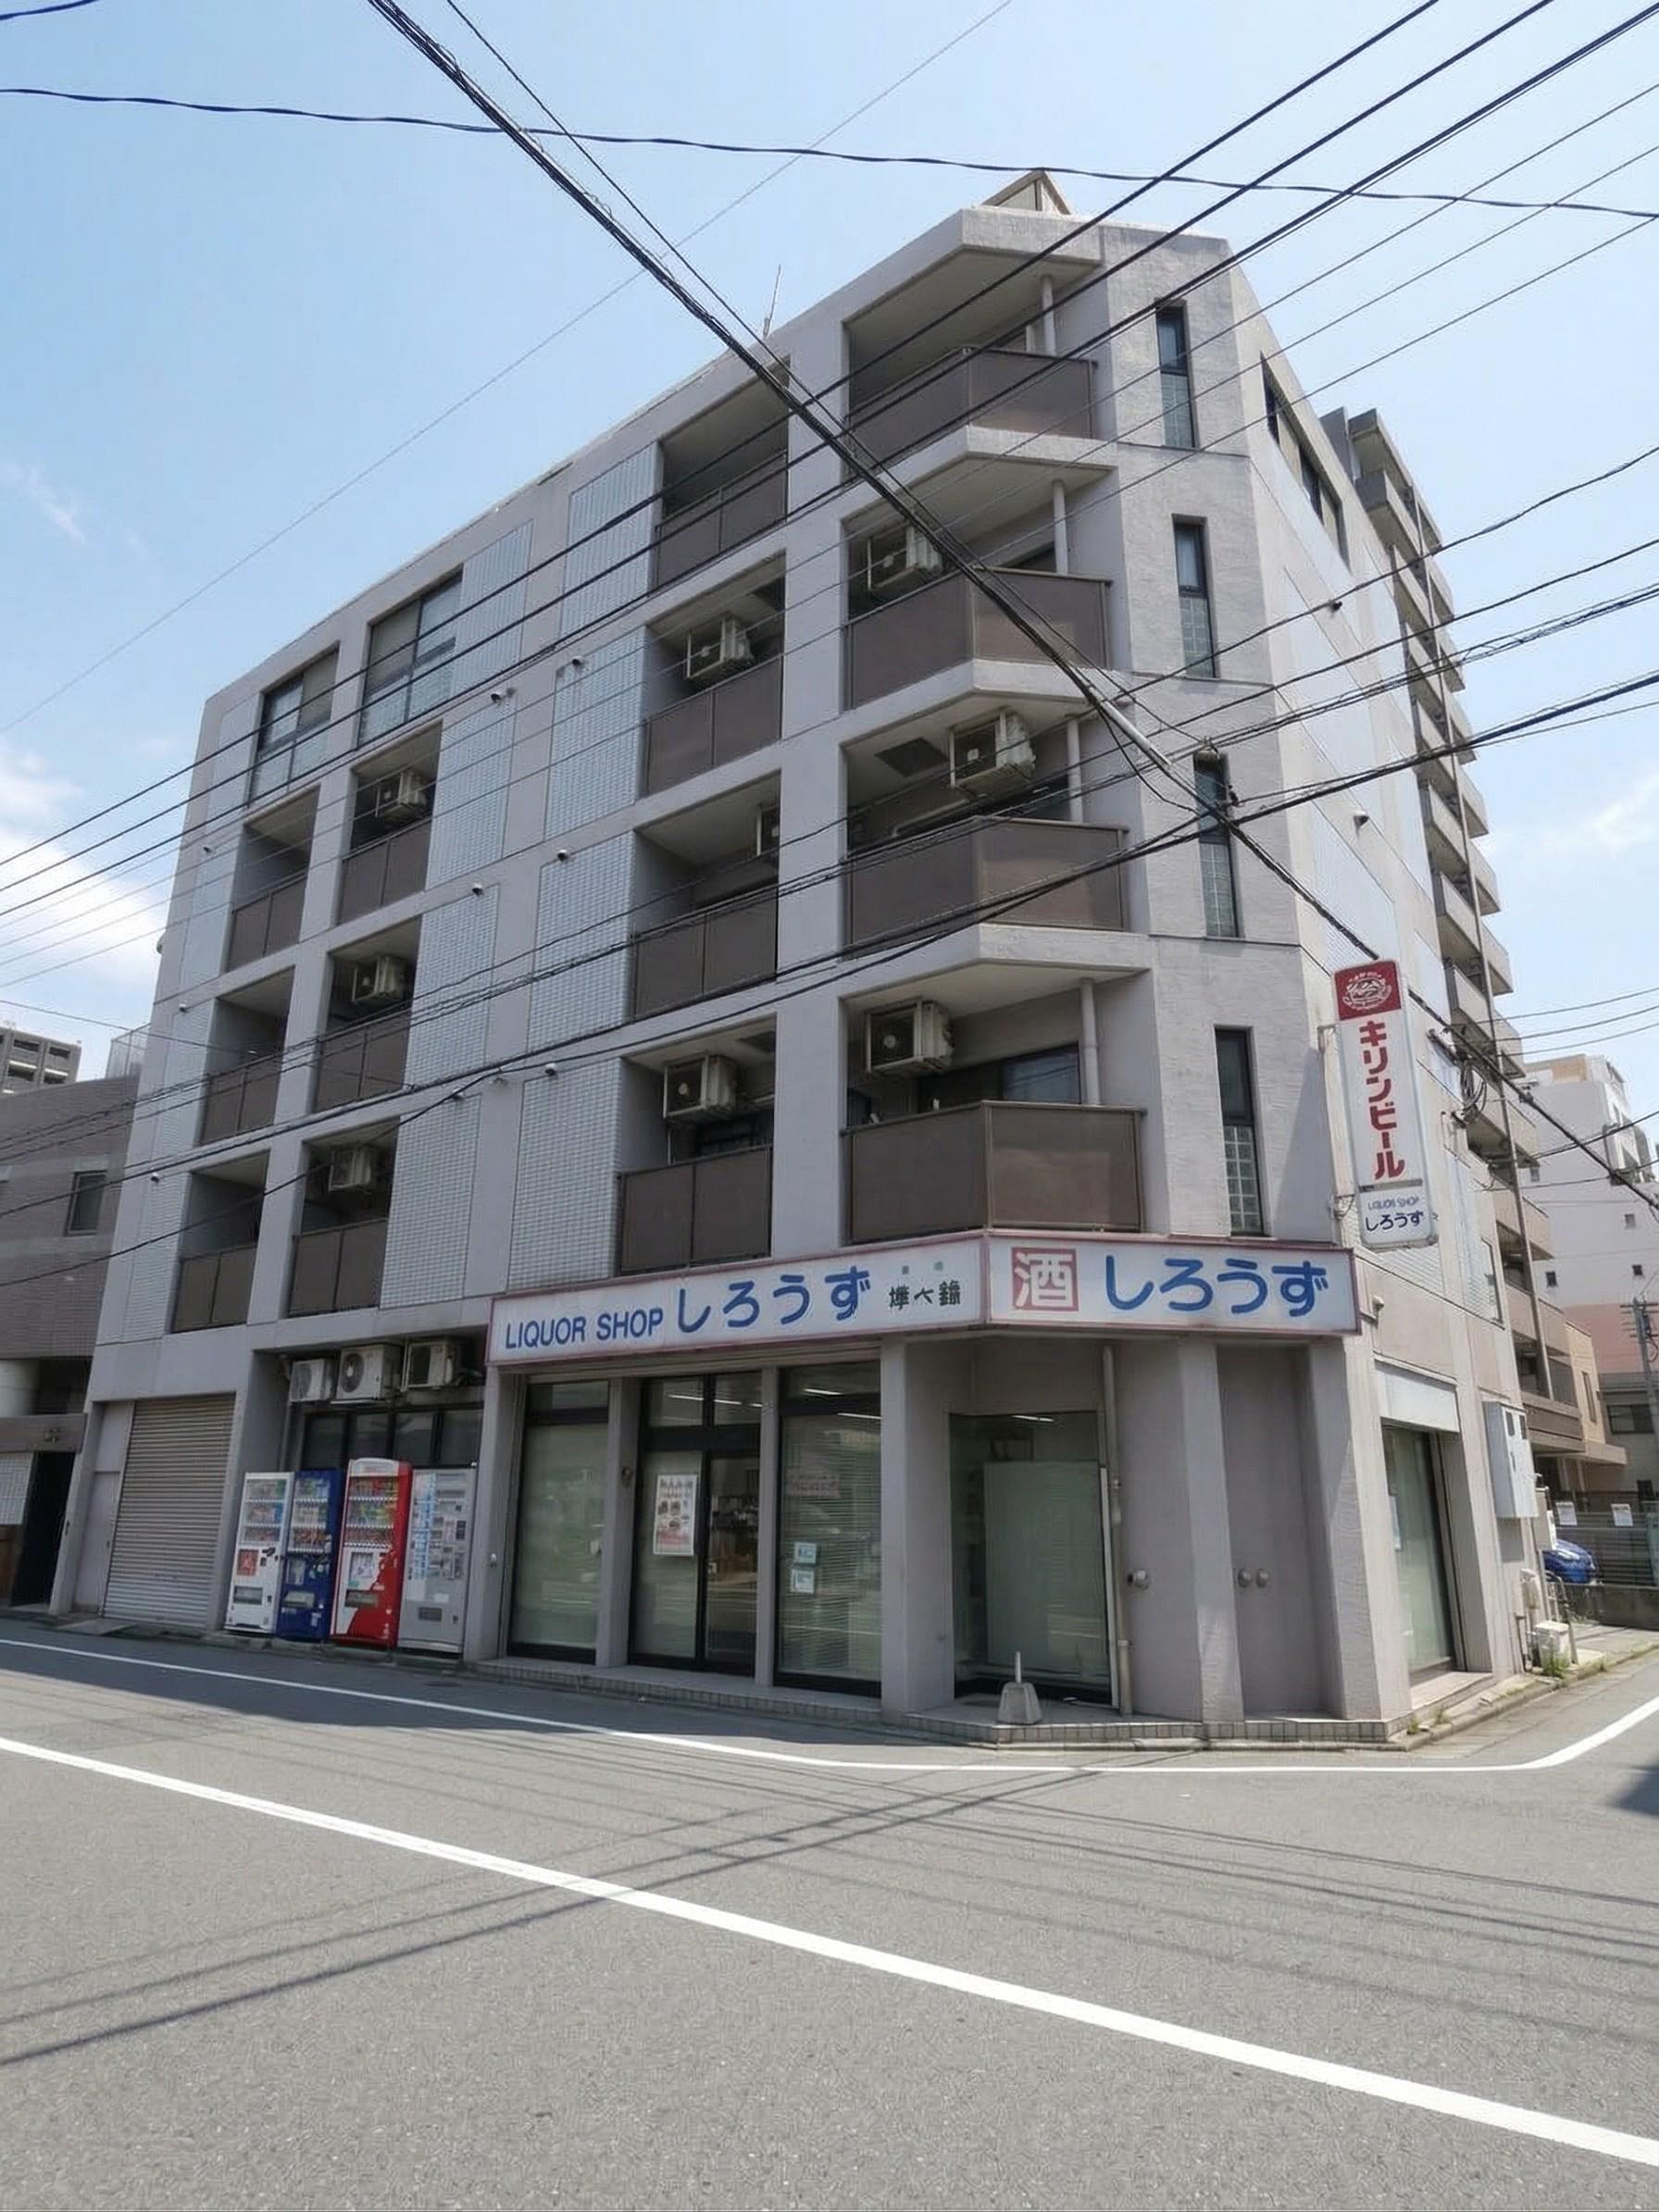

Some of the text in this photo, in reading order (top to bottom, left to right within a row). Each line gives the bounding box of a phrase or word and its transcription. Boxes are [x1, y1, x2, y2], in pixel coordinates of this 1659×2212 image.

[1359, 1020, 1405, 1180] キリンビール
[505, 1316, 587, 1348] LIQUOR
[595, 1307, 664, 1341] SHOP
[678, 1265, 871, 1334] しろうず
[1015, 1251, 1077, 1309] 酒
[1105, 1255, 1328, 1317] しろうず
